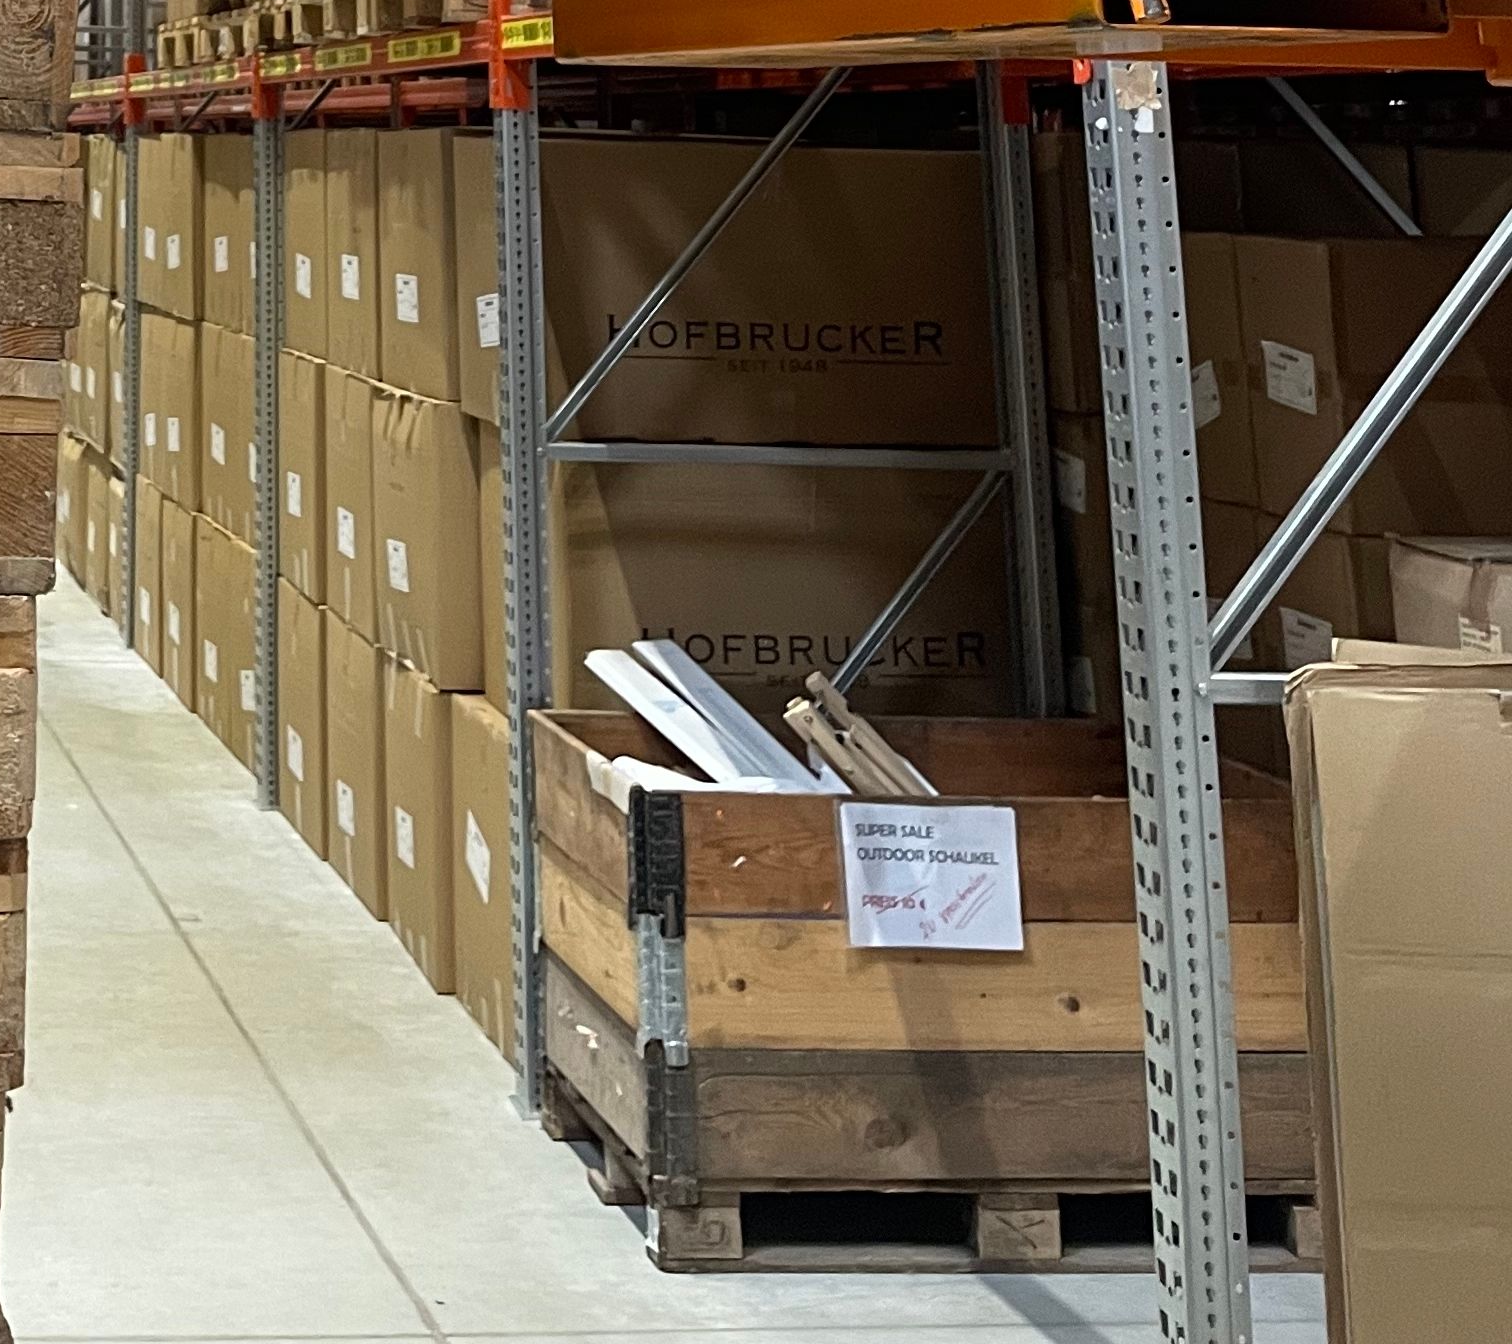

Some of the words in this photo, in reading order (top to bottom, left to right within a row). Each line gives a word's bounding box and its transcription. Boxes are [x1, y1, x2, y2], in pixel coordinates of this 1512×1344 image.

[641, 627, 986, 668] OFBRUKER
[855, 823, 897, 838] SUPER
[901, 824, 935, 839] SALE
[856, 847, 925, 862] OUTDOOR
[929, 849, 1000, 866] SCHAUKEL
